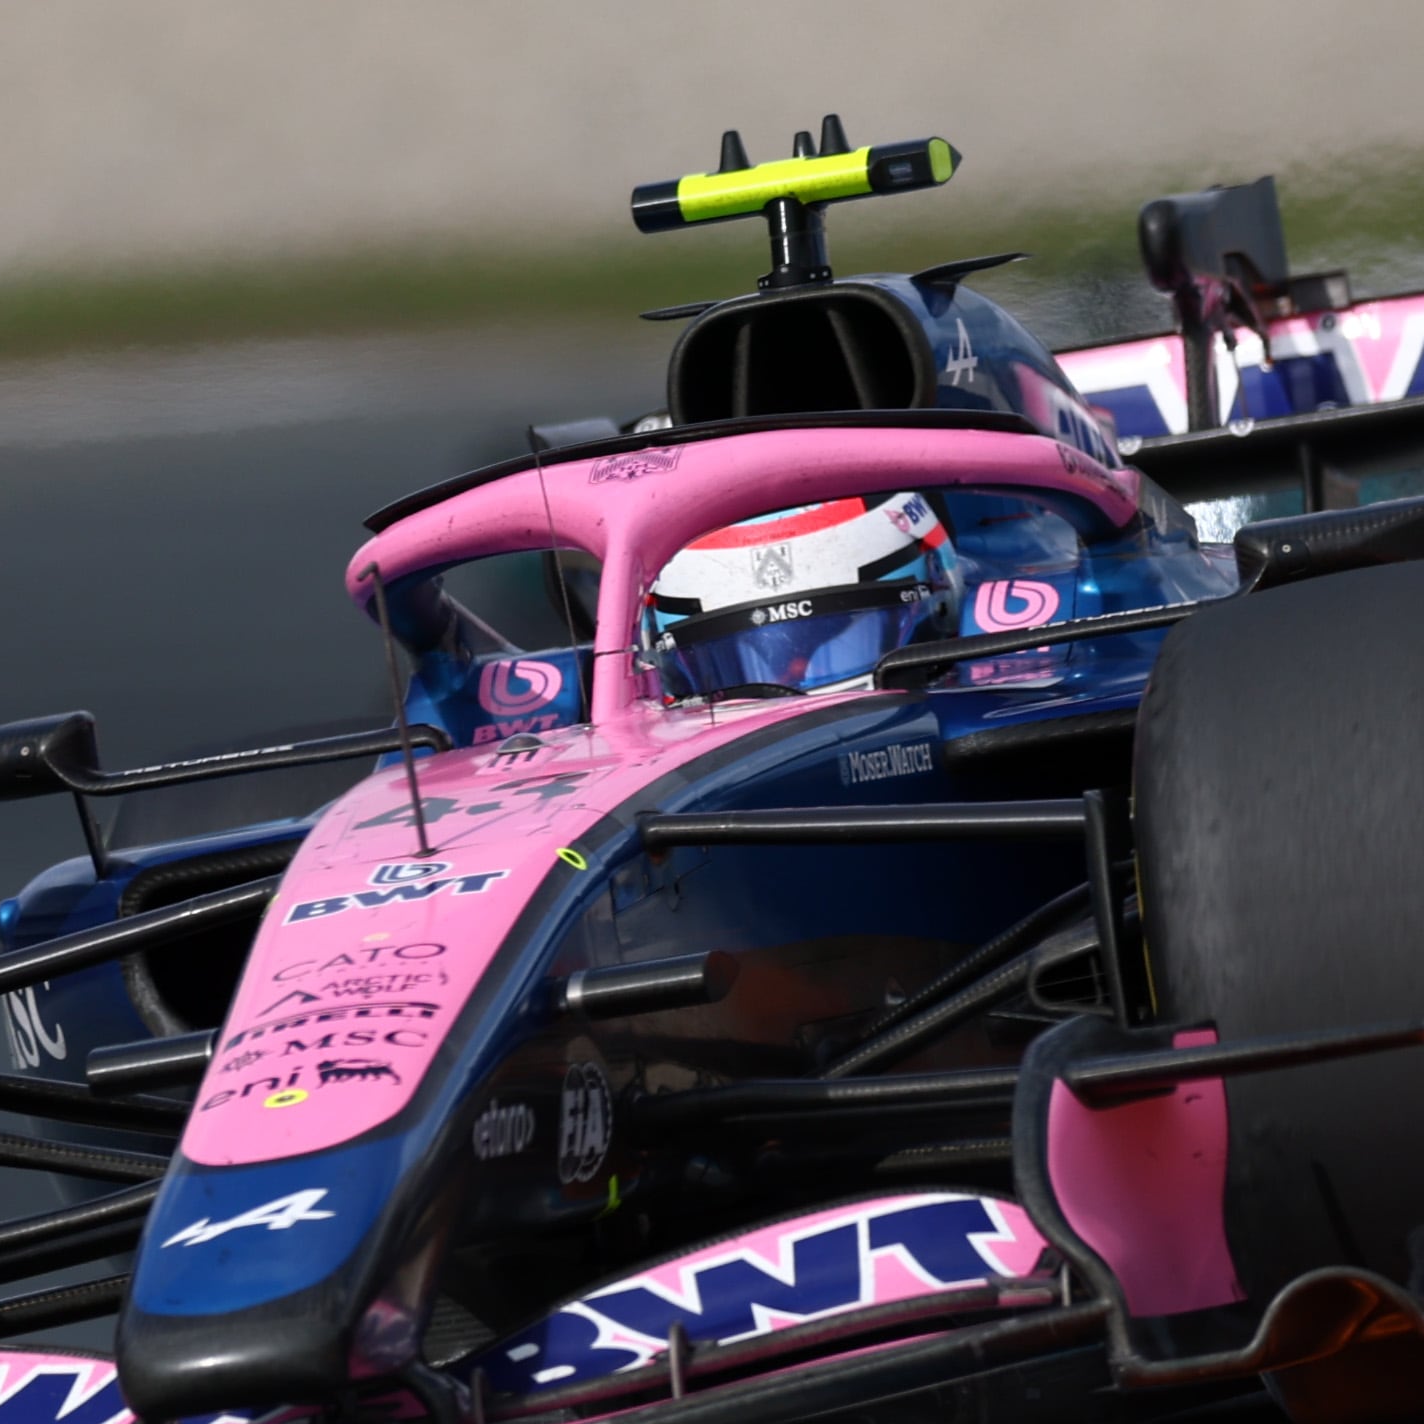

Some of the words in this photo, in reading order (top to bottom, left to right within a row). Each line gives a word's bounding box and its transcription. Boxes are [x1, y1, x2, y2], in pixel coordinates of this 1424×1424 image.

[902, 491, 927, 525] BW
[769, 601, 813, 622] MSC
[472, 713, 559, 745] BWT
[283, 870, 510, 925] BWT
[272, 943, 447, 982] CATO
[322, 973, 433, 992] ARCTIC
[333, 982, 419, 998] WOLF
[3, 978, 67, 1069] SC
[225, 1002, 442, 1050] PIRELLI
[279, 1030, 428, 1058] MSC
[201, 1066, 301, 1112] eni
[461, 1197, 1010, 1398] BWT
